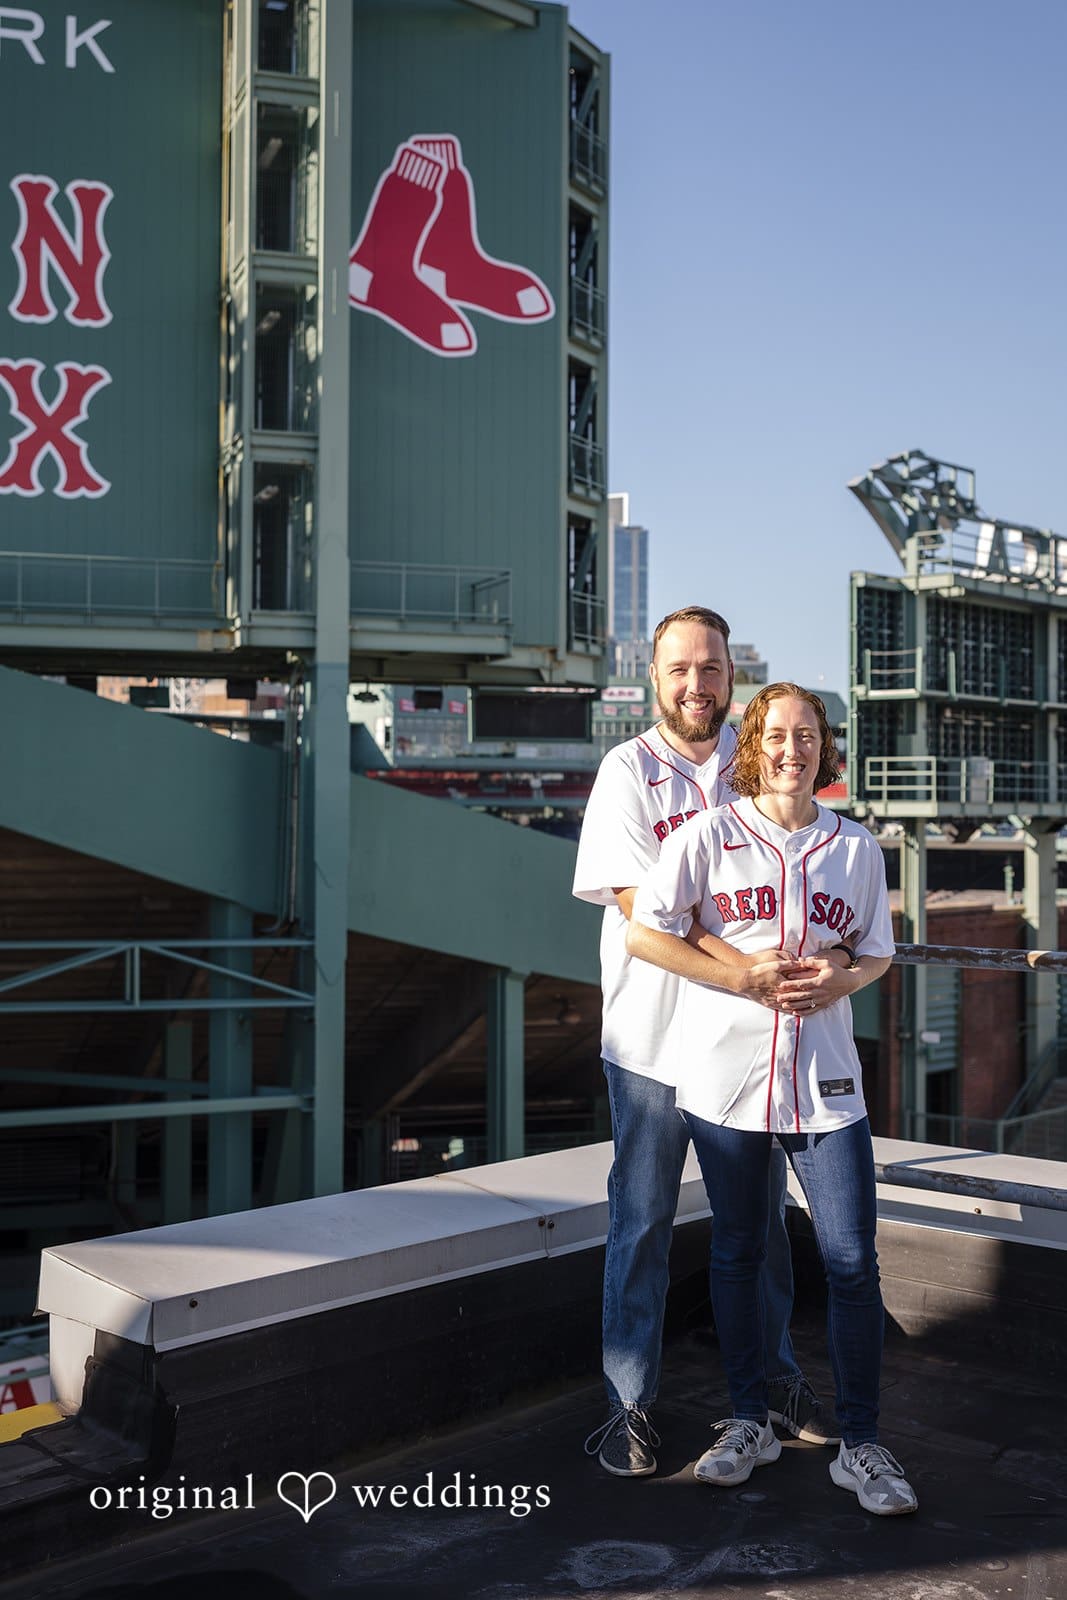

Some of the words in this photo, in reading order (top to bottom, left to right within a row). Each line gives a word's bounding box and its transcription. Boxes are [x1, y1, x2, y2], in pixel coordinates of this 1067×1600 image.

[9, 174, 114, 328] N
[0, 357, 112, 500] X
[712, 885, 777, 923] RED
[810, 892, 855, 939] SOX
